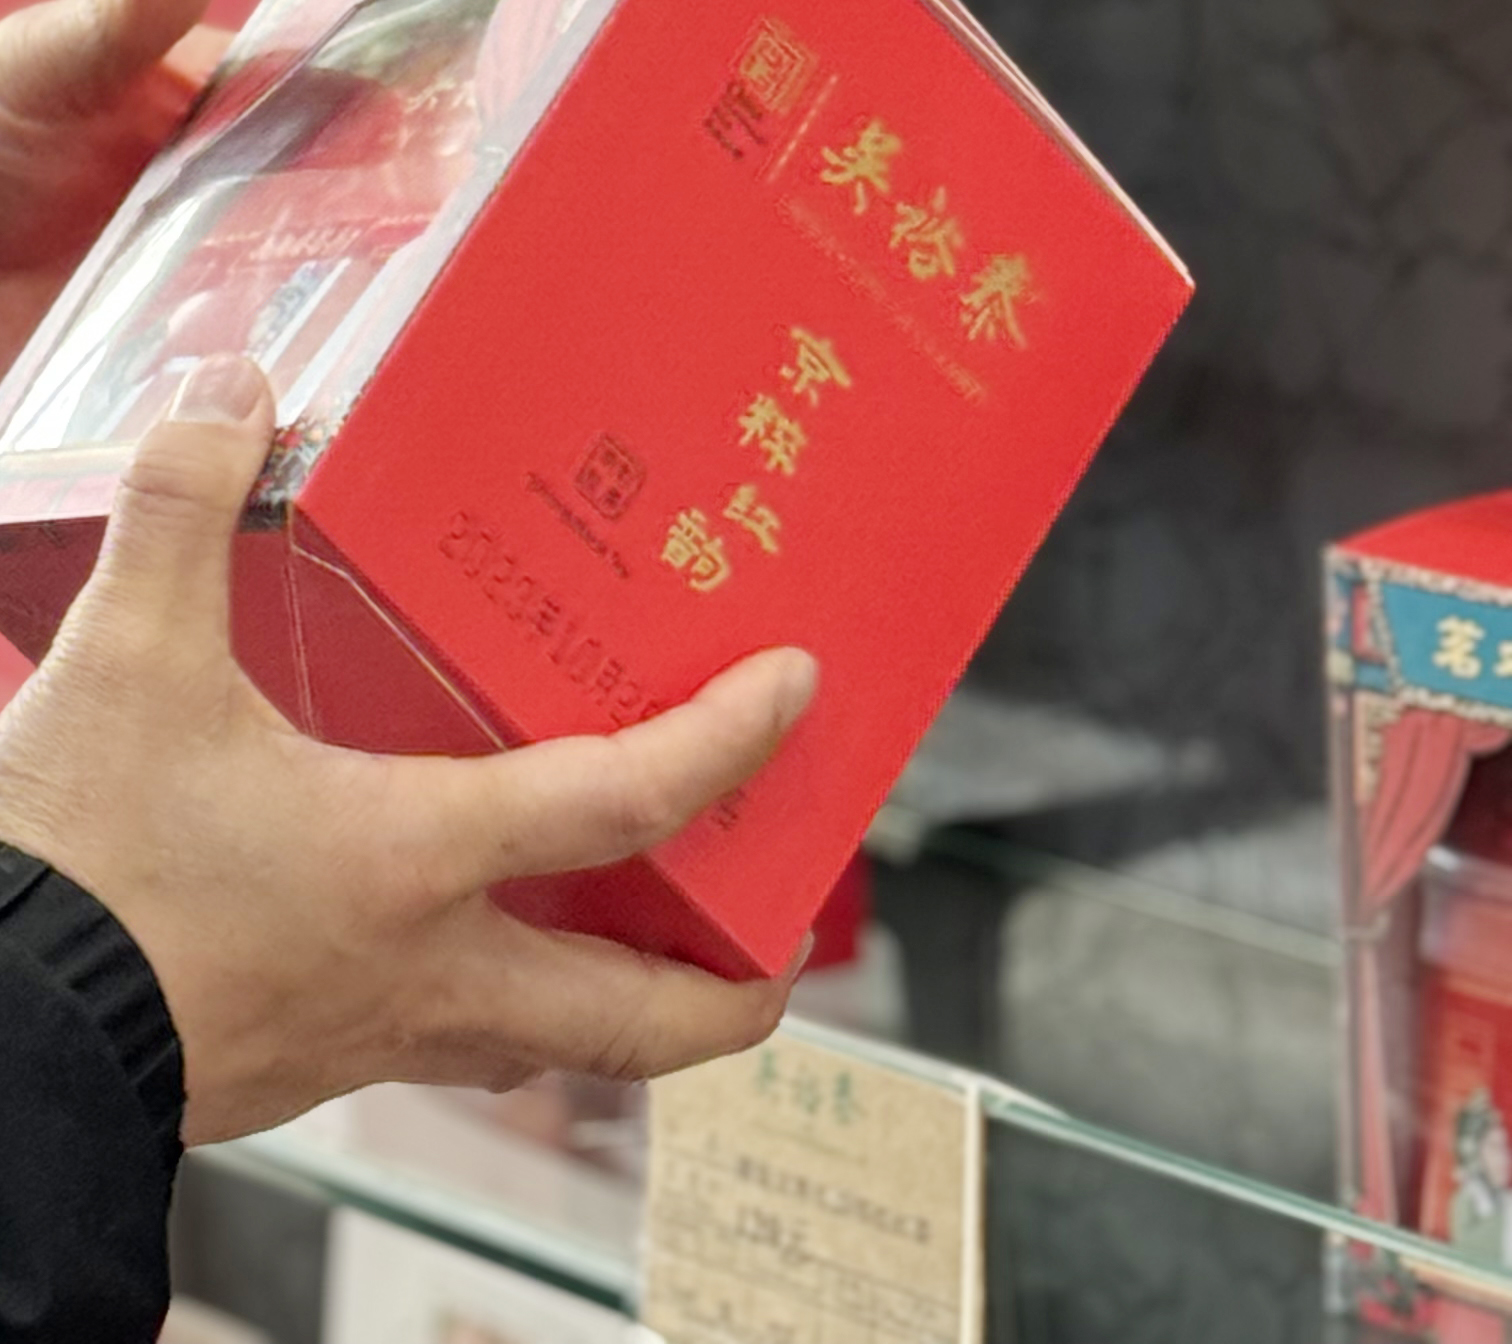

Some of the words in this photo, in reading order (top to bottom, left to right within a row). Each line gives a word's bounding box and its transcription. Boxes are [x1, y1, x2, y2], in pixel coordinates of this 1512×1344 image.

[820, 119, 1034, 349] 吴裕泰
[661, 326, 851, 592] 京粹红韵
